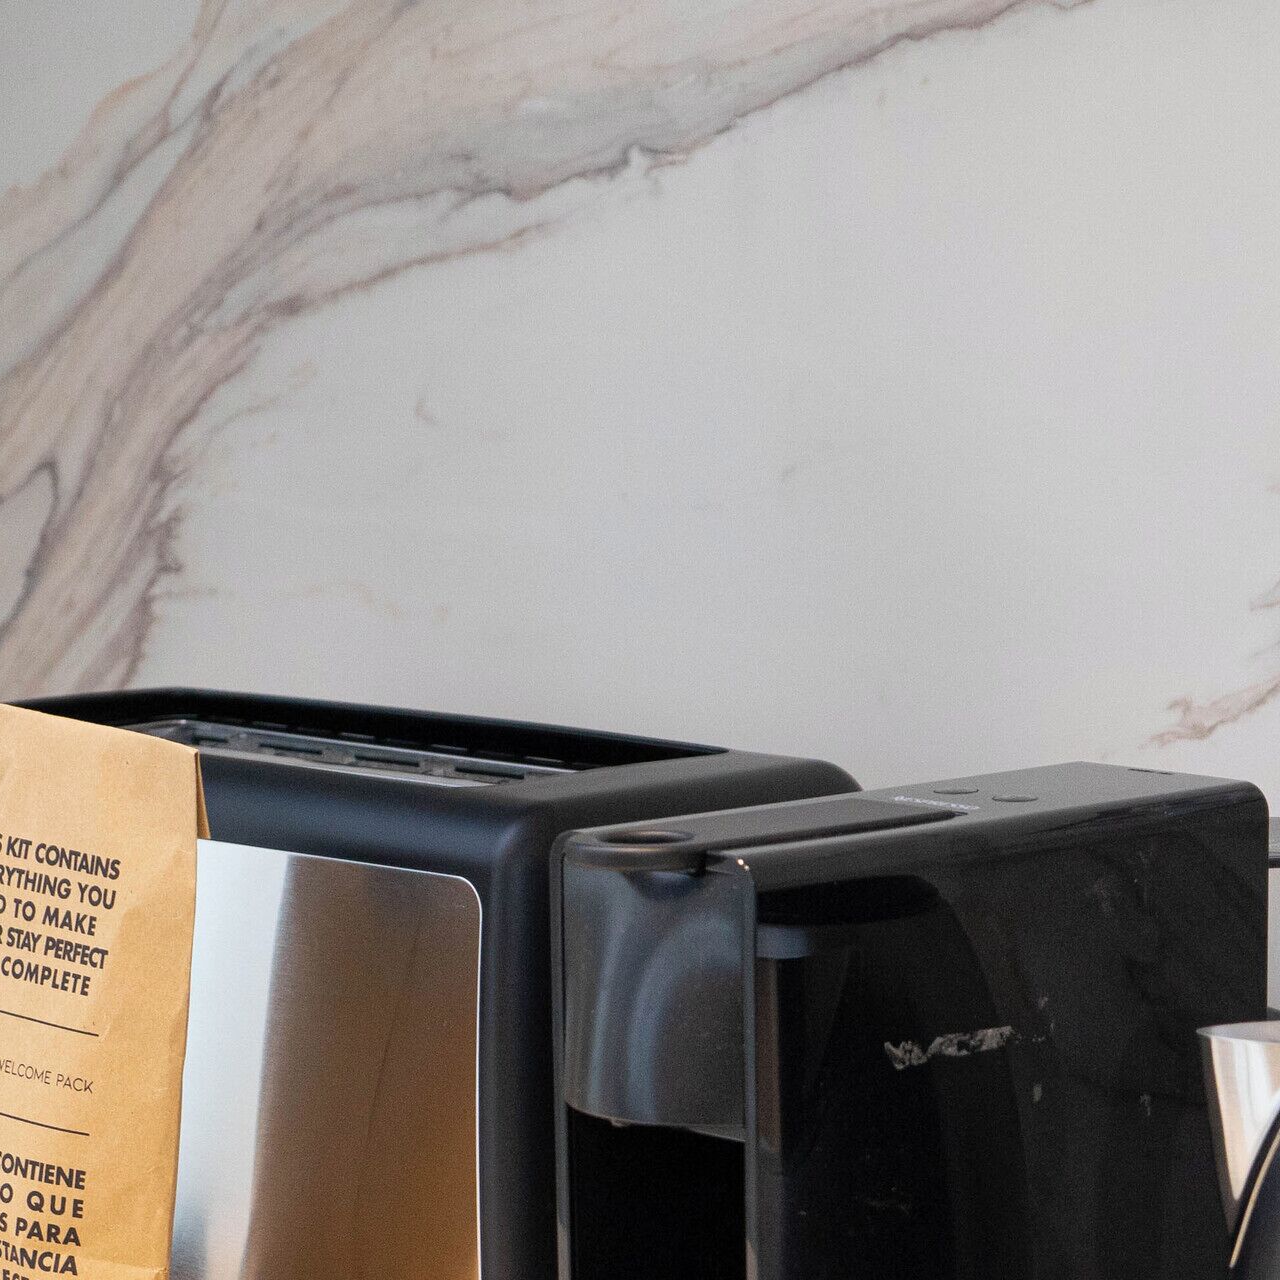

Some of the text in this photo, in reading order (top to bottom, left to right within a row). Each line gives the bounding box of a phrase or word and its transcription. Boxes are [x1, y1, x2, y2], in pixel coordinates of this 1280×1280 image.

[6, 836, 32, 861] KIT
[34, 842, 120, 881] CONTAINS
[77, 882, 117, 911] YOU
[13, 897, 36, 922] TO
[41, 908, 97, 937] MAKE
[6, 927, 42, 953] STAY
[43, 937, 109, 970] PERFECT
[0, 956, 91, 997] COMPLETE
[55, 1073, 94, 1094] PACK
[26, 1191, 84, 1219] QUE
[15, 1217, 82, 1247] PARA
